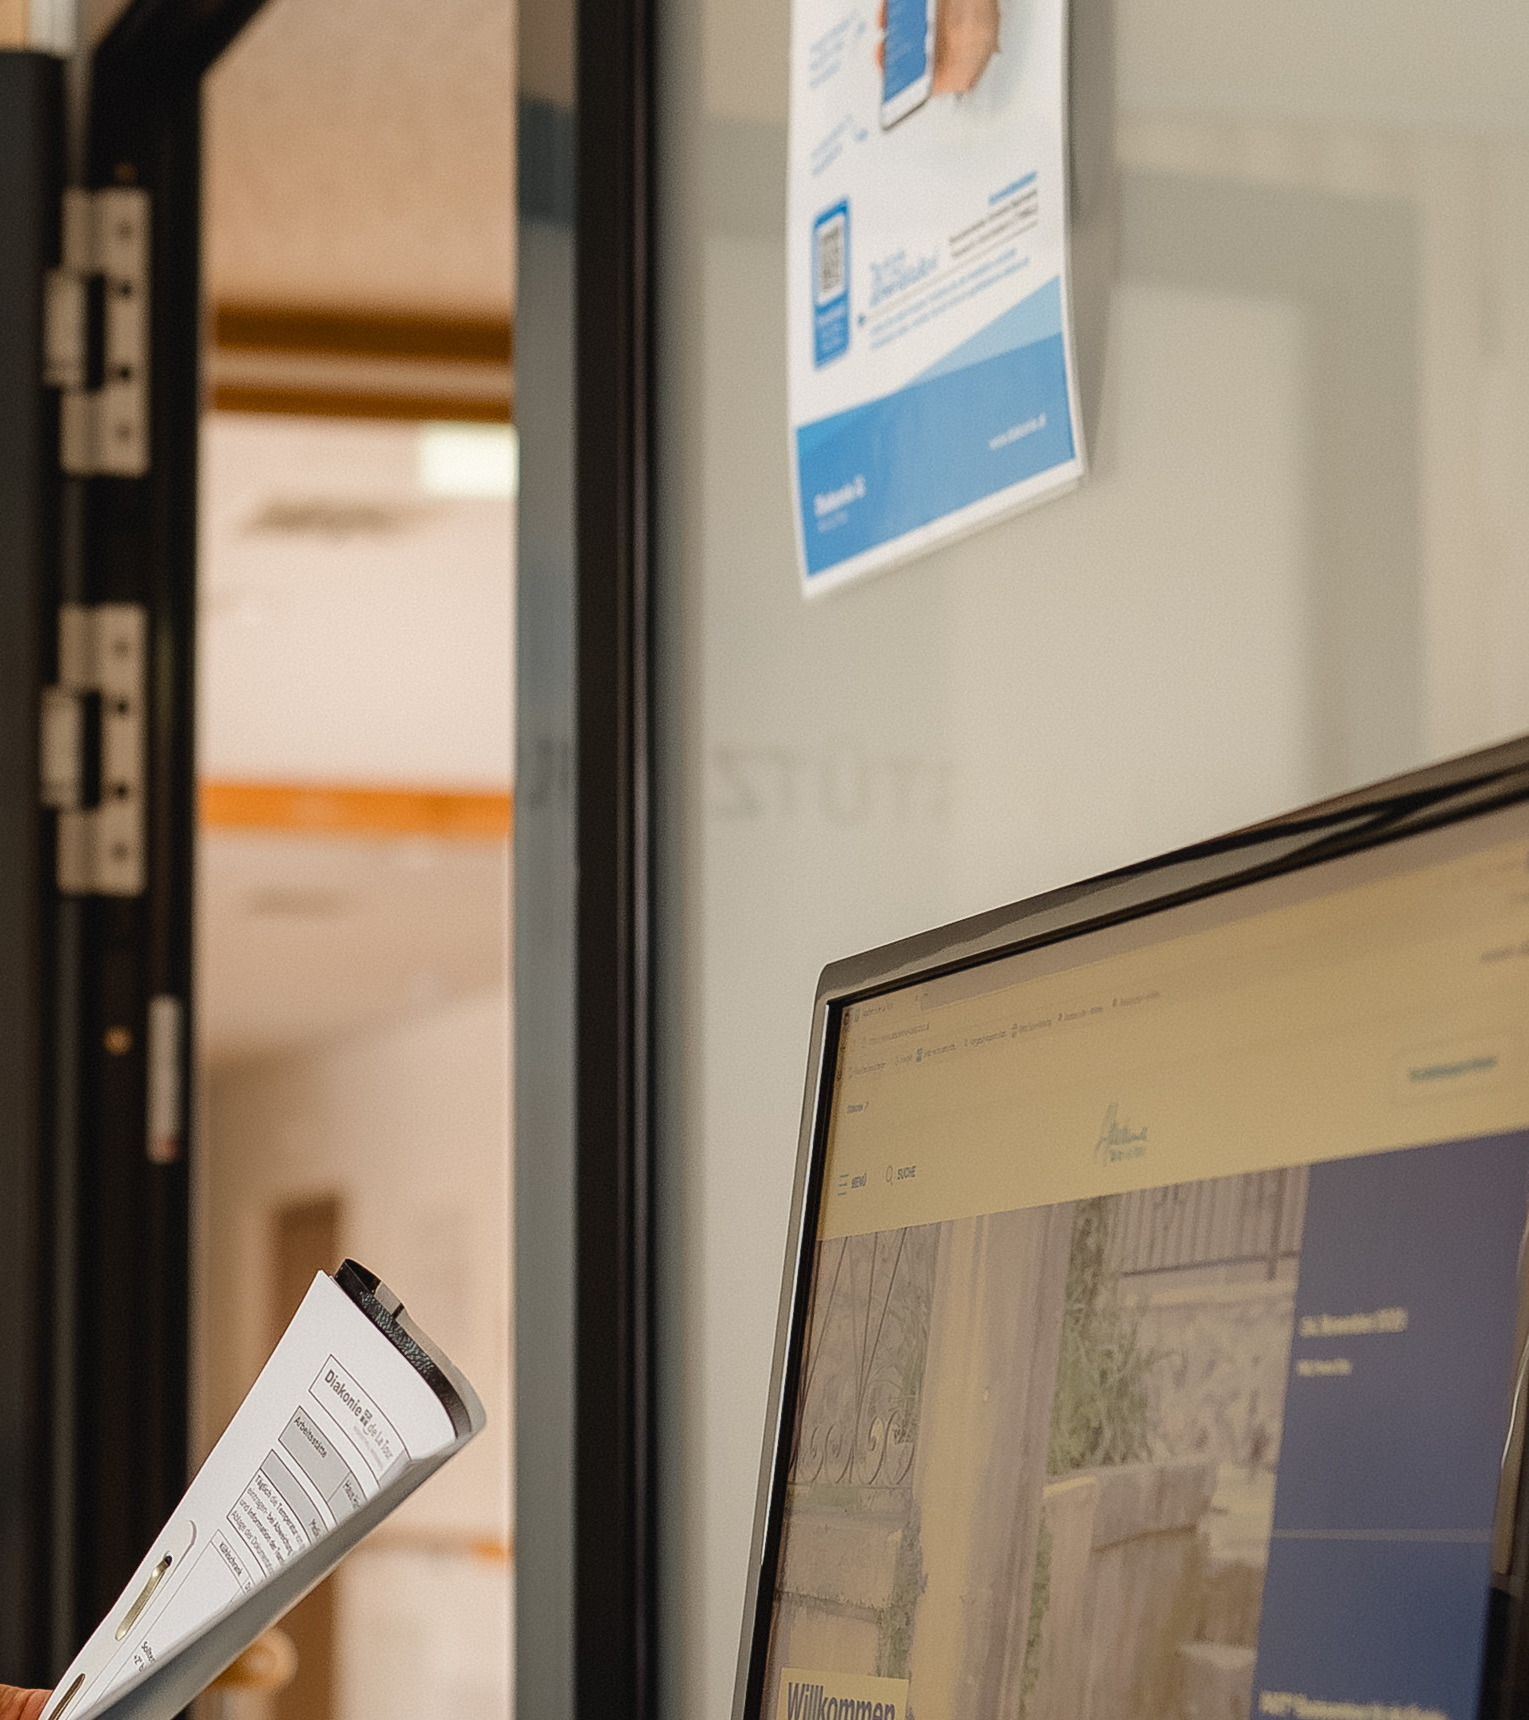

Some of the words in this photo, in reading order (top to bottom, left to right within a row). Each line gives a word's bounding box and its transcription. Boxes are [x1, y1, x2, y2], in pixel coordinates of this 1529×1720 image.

[324, 1369, 362, 1417] Diakonie
[293, 1416, 327, 1458] Arbeitsstätte
[248, 1507, 271, 1541] Information
[255, 1474, 272, 1498] Täglich
[277, 1502, 299, 1536] Temperatur
[219, 1541, 243, 1577] Kühlschrank
[788, 1681, 896, 1720] Willkommen
